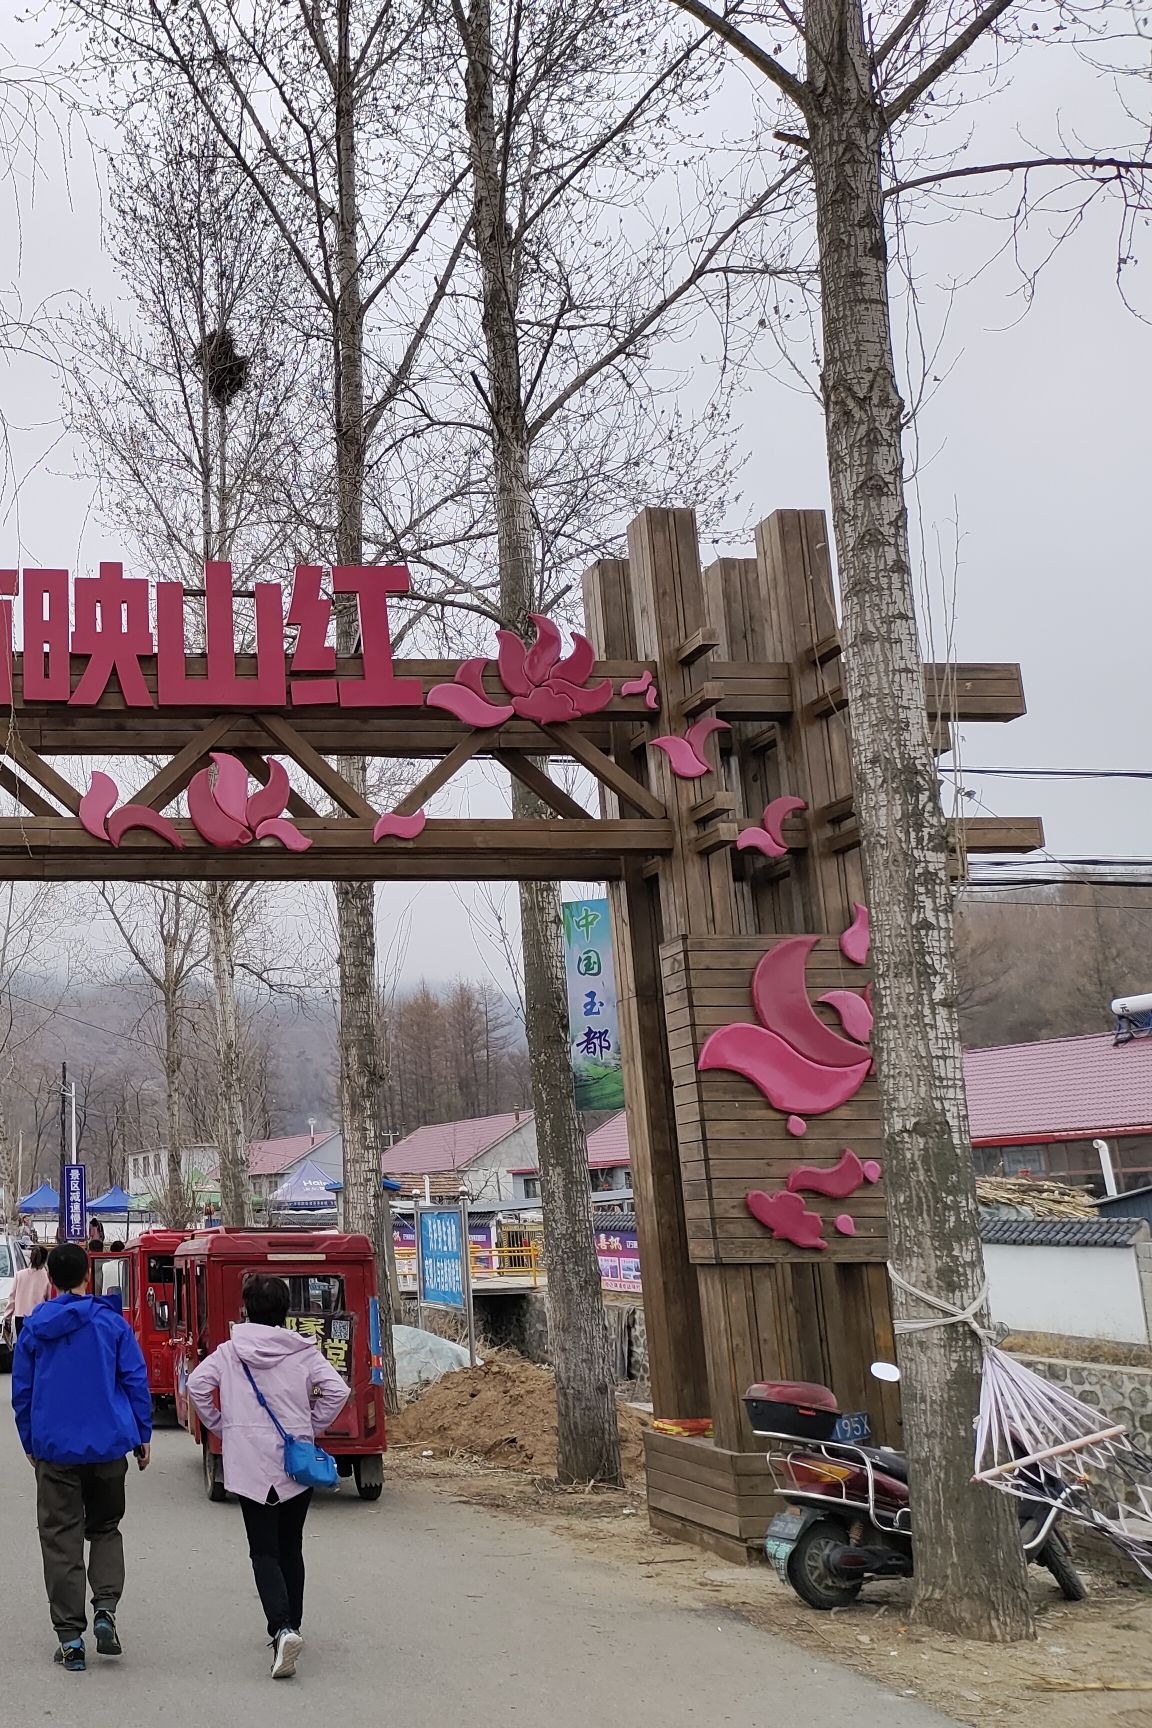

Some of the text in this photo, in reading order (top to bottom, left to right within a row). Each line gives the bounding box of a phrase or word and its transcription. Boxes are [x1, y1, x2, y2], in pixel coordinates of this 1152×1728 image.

[573, 906, 611, 1062] 中国玉都
[69, 1168, 82, 1236] 景区减速慢行
